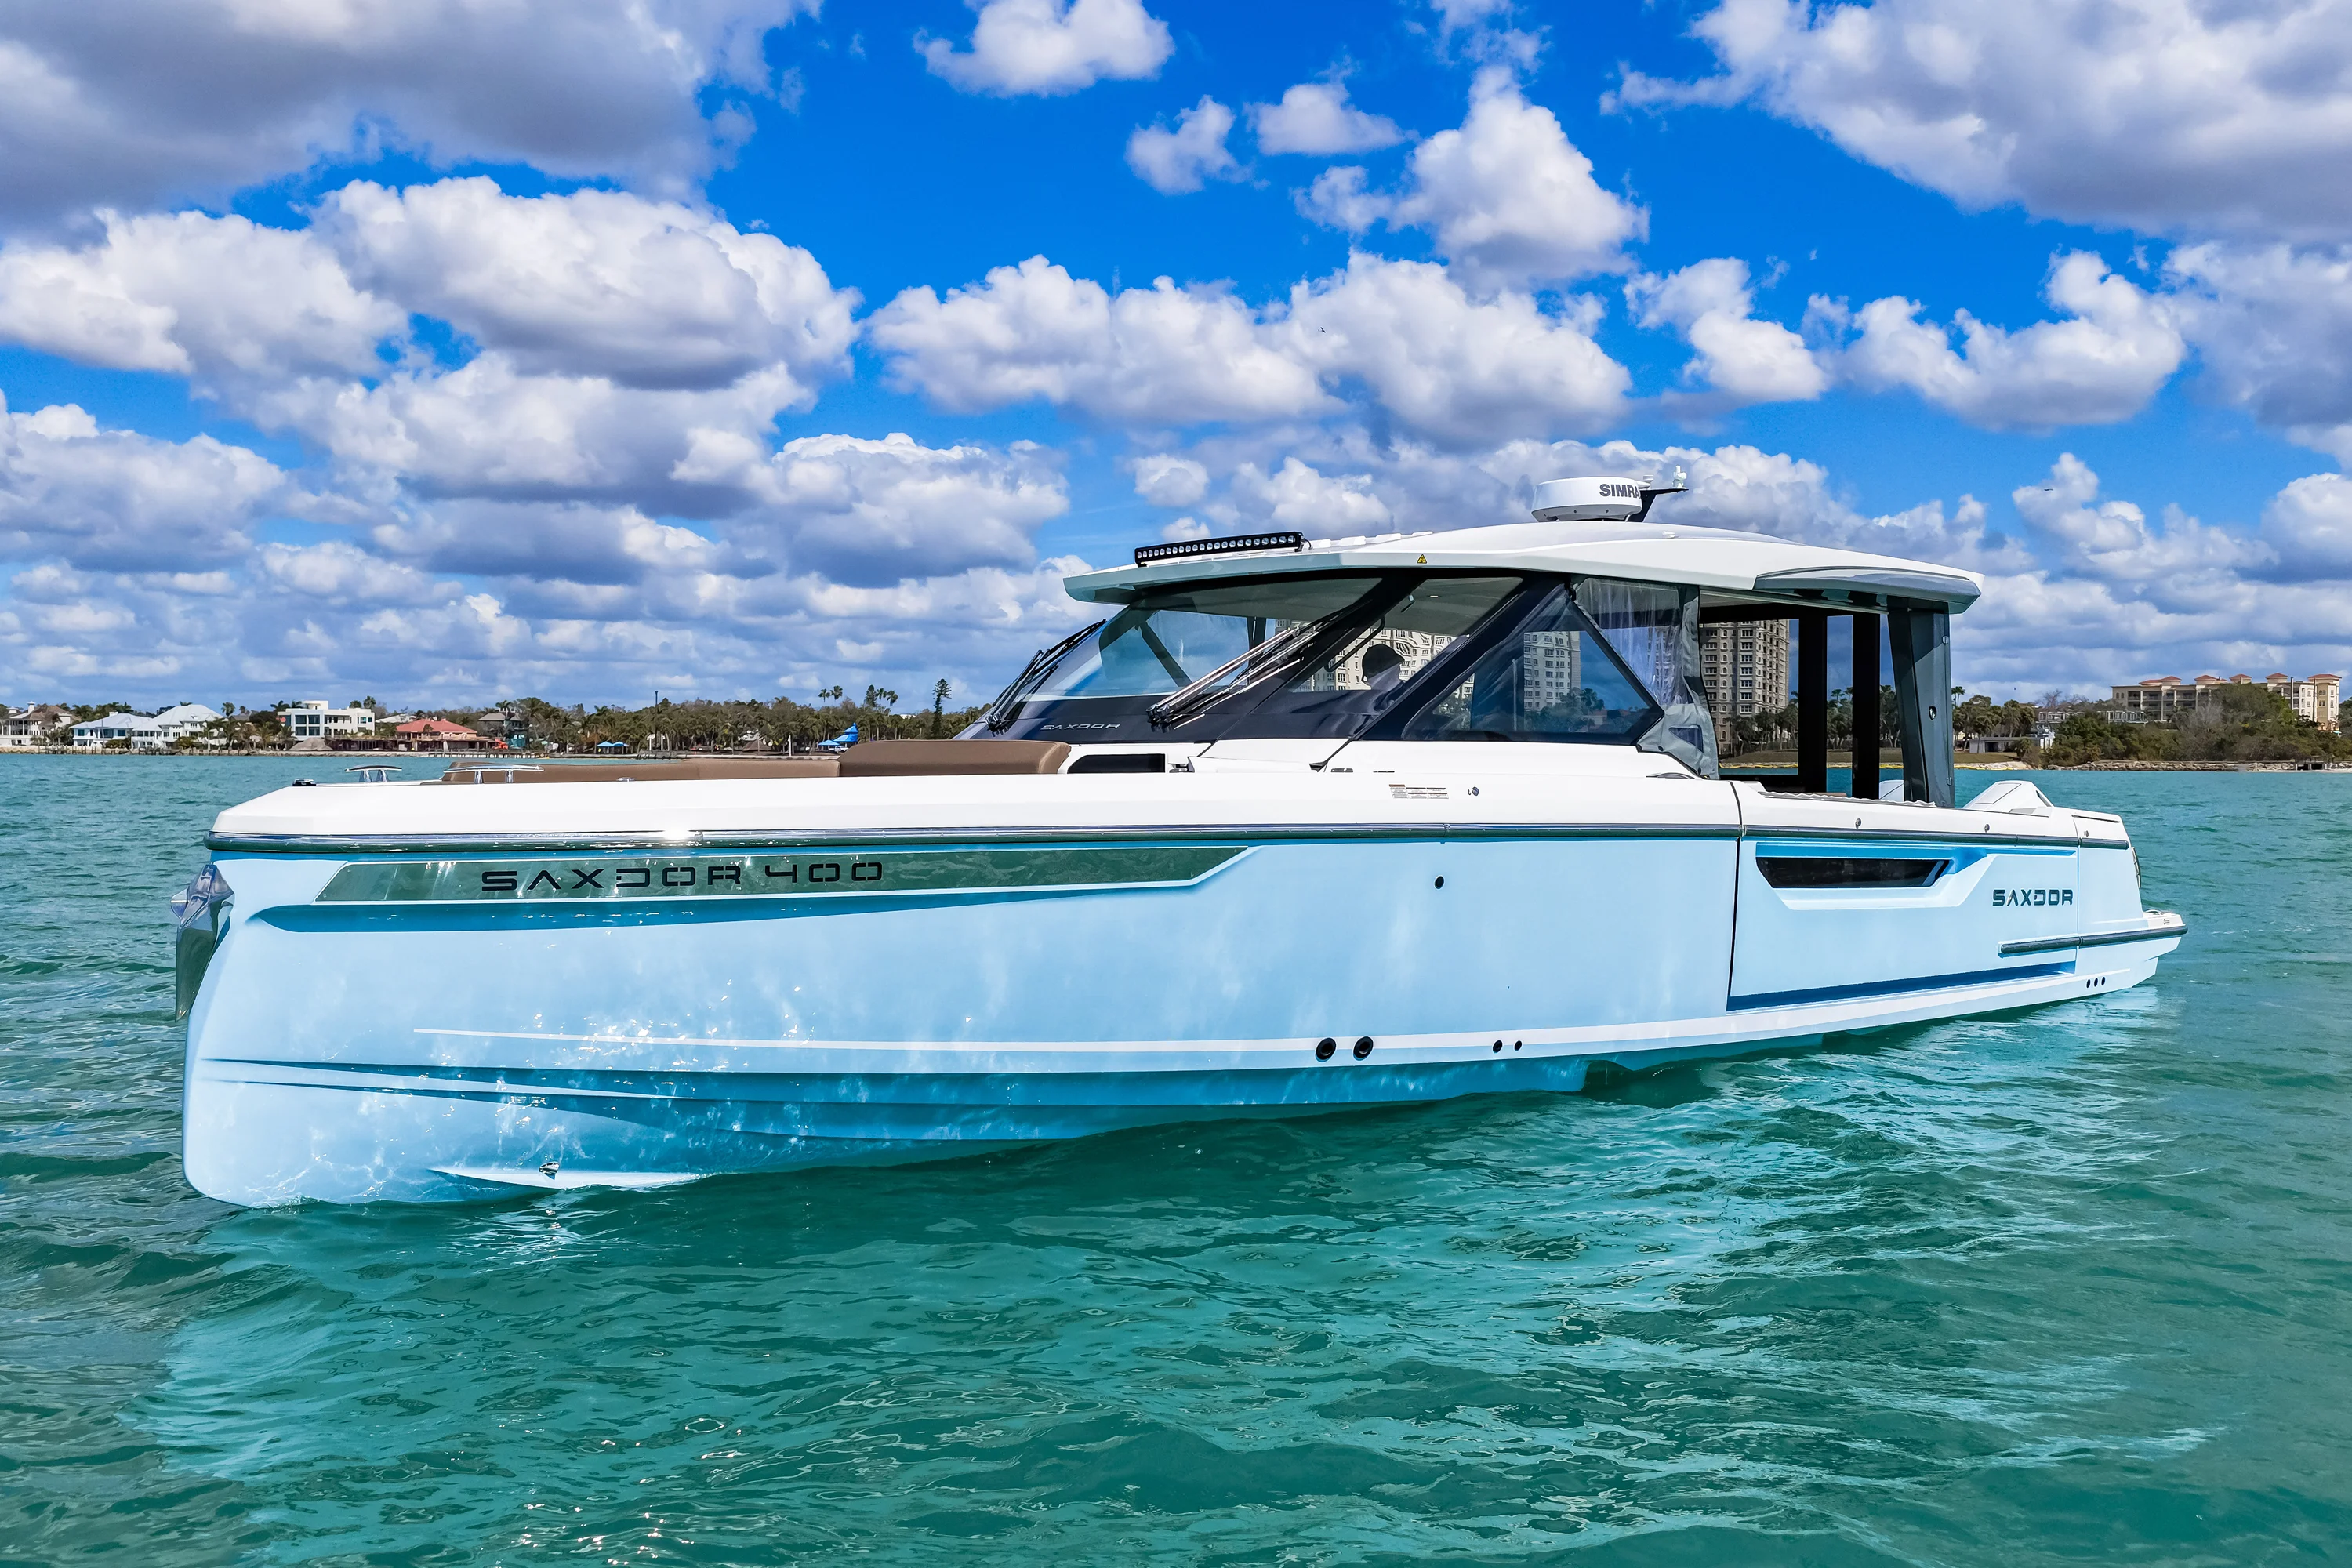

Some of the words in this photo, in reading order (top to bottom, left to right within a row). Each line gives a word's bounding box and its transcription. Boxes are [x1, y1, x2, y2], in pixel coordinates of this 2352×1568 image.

[481, 866, 742, 891] SAXDOR
[765, 862, 884, 884] 400
[1992, 889, 2074, 906] SAXDOR
